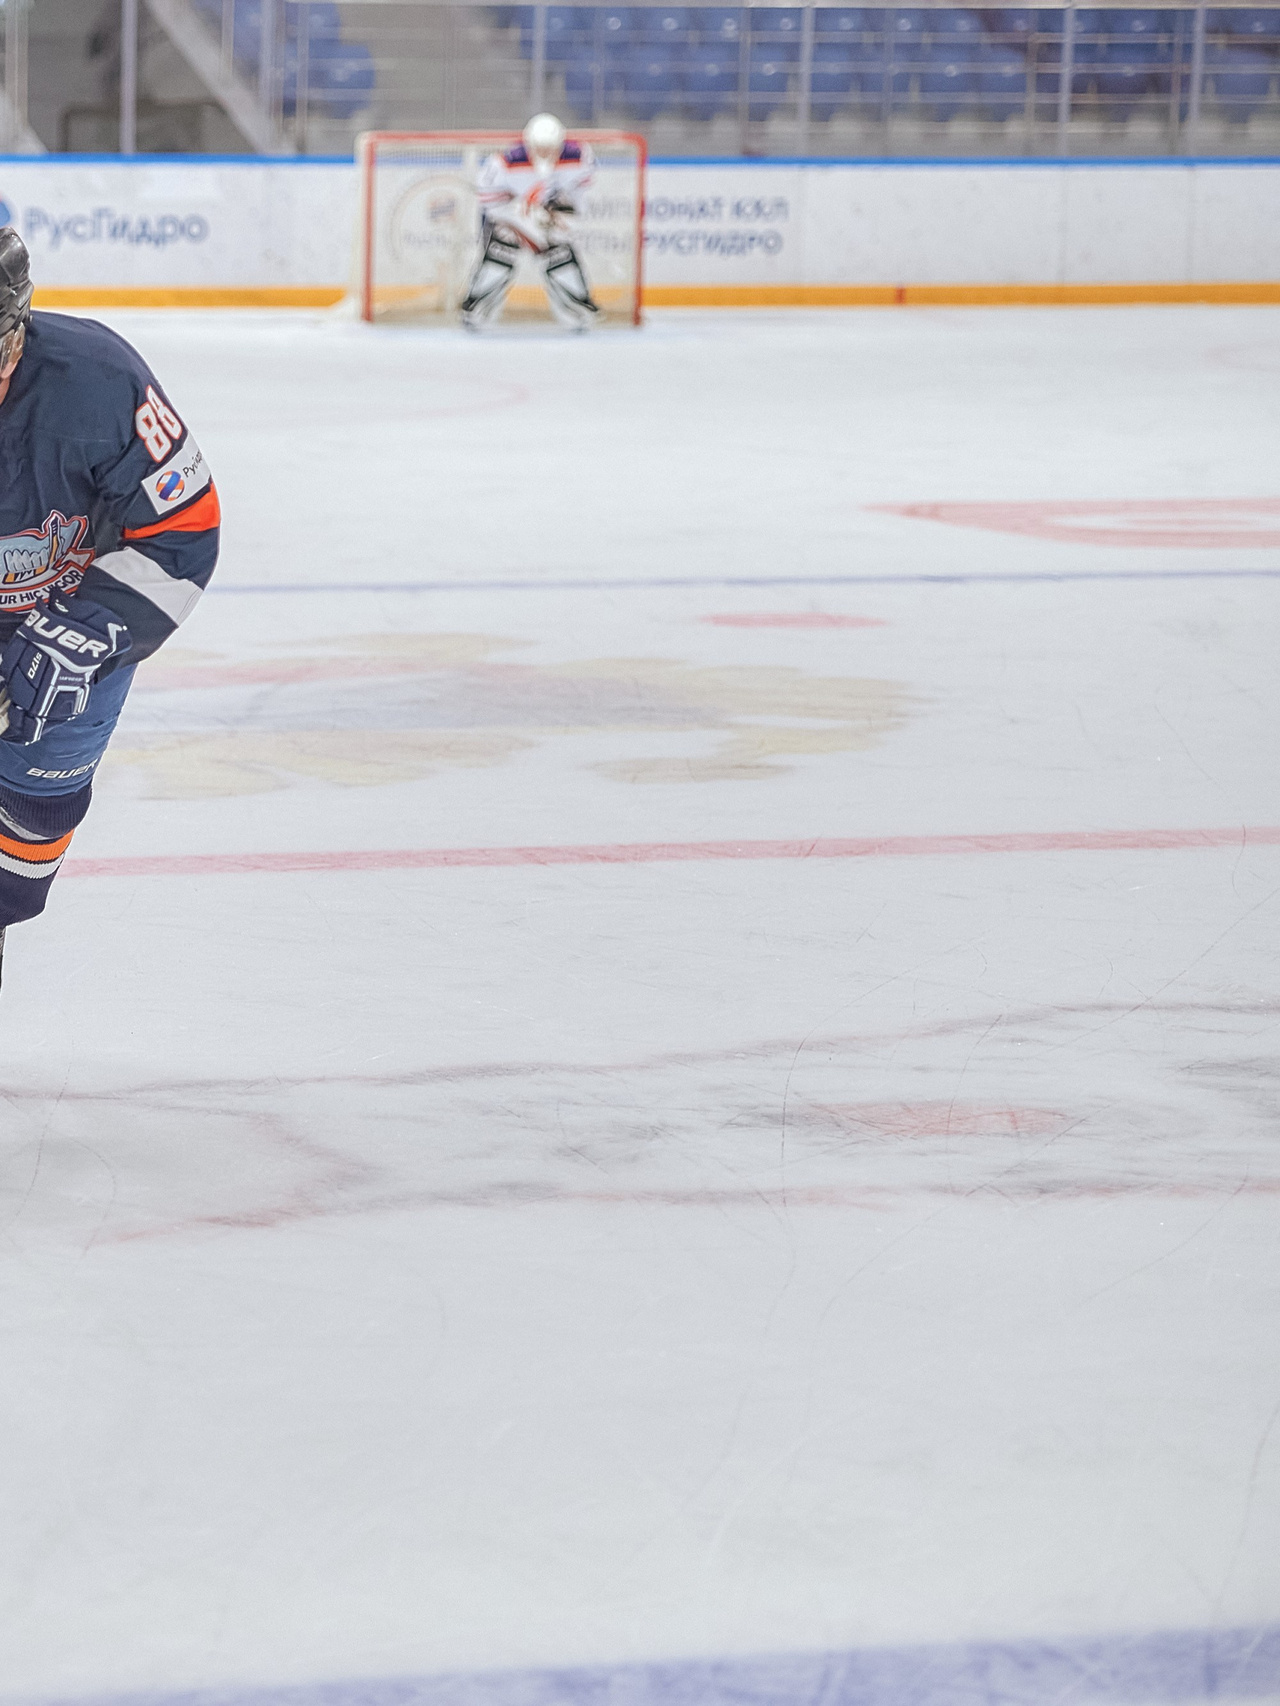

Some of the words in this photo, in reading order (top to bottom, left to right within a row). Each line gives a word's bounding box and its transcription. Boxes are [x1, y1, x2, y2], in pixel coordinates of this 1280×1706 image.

[24, 206, 209, 249] РусГидро
[20, 590, 44, 603] HIC
[24, 608, 109, 658] AUER
[26, 759, 98, 779] BAUER
